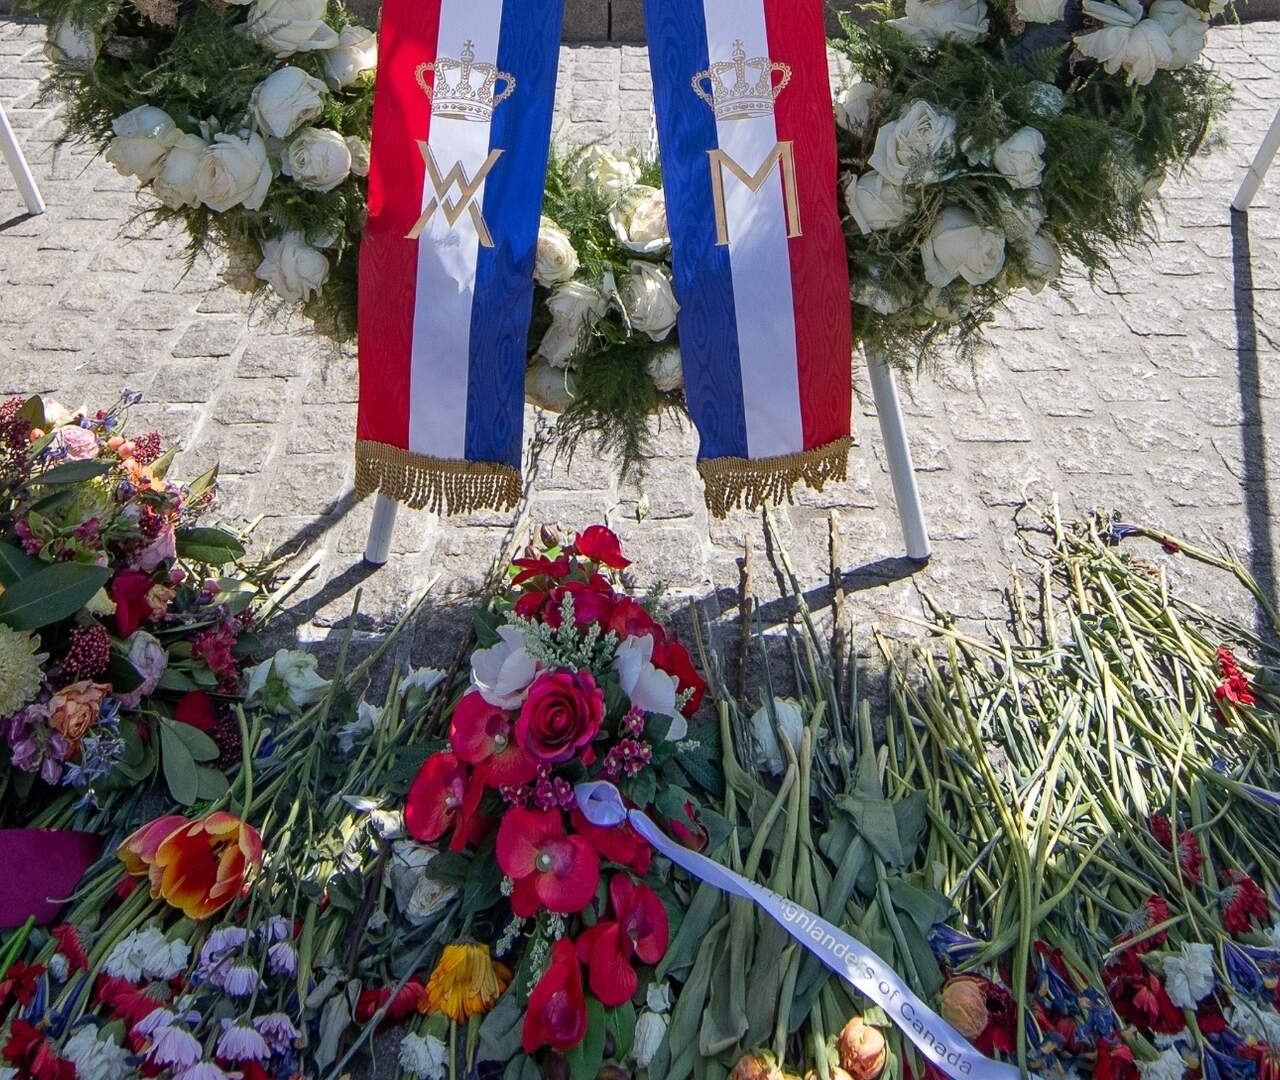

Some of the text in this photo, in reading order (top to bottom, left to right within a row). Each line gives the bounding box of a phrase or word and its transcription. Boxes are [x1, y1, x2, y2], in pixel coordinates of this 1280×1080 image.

[705, 140, 803, 247] M
[878, 979, 900, 1003] of
[900, 1001, 973, 1076] Canada
